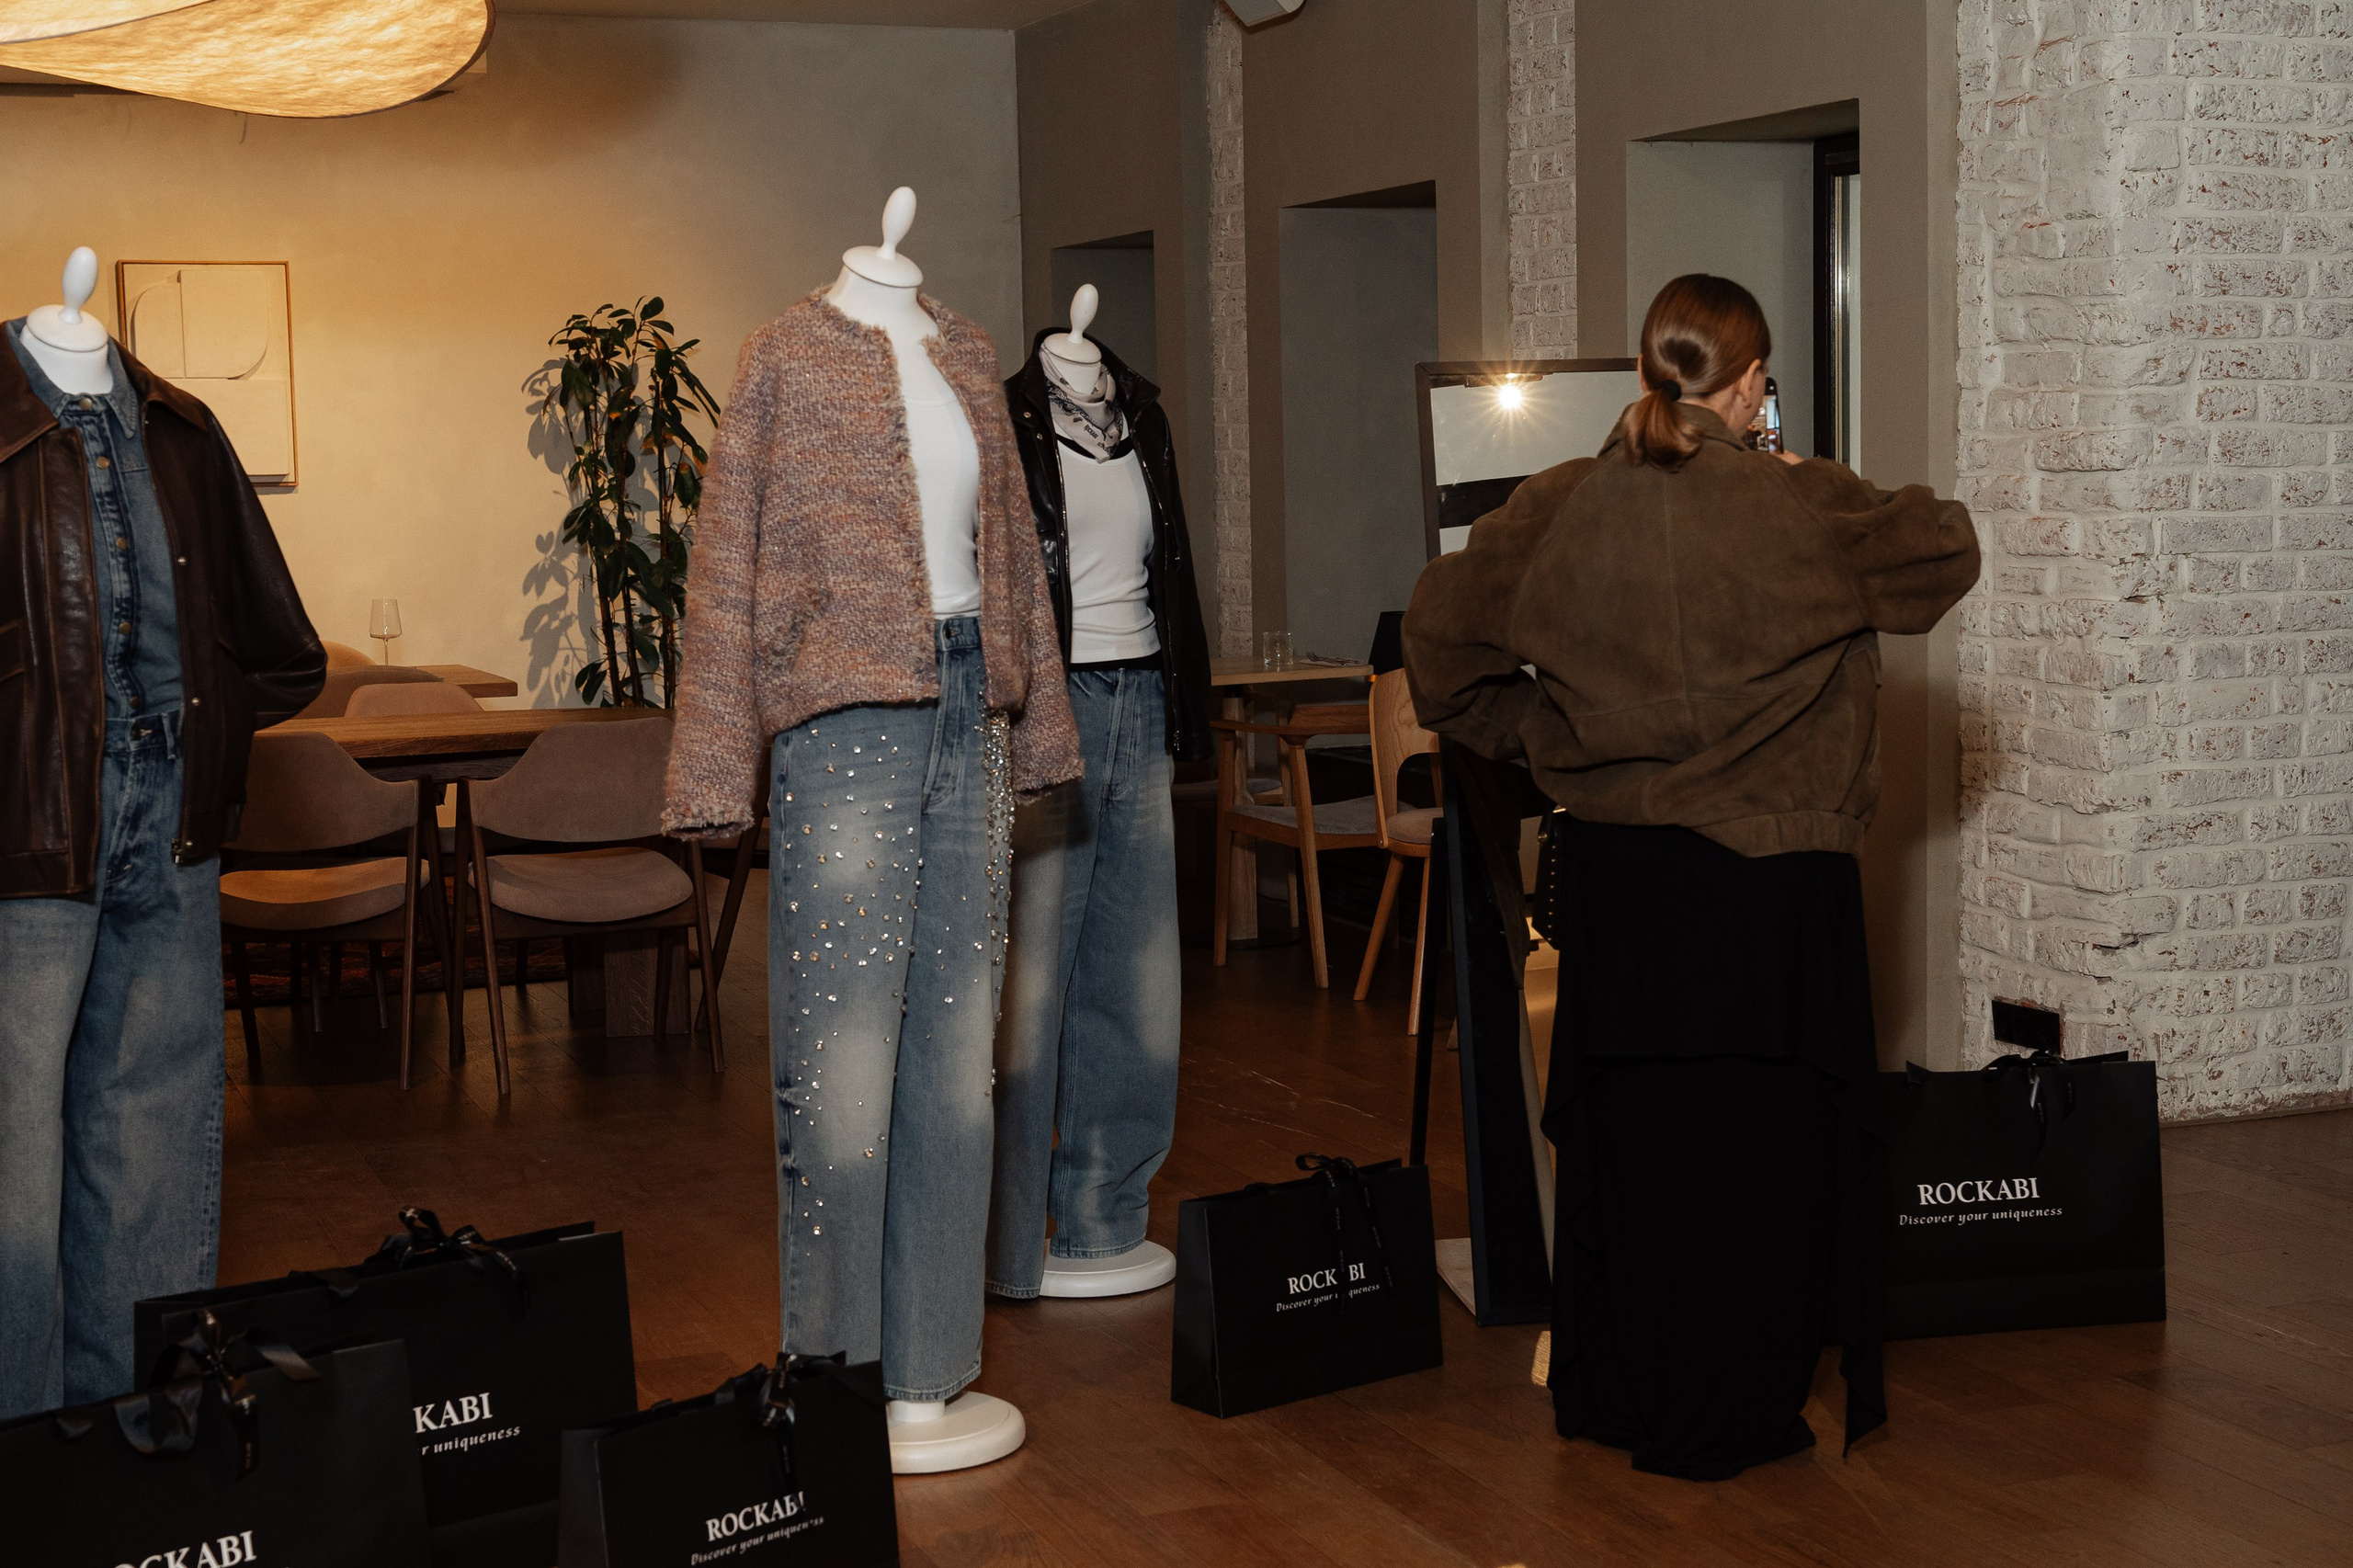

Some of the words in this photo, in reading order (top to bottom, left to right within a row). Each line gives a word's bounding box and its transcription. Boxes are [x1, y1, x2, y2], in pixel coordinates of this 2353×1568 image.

[1916, 1177, 2040, 1206] ROCKABI
[1899, 1214, 1955, 1225] Discover
[1958, 1212, 1989, 1226] your
[1992, 1208, 2063, 1221] uniqueness
[1287, 1262, 1366, 1294] ROCKBI
[1276, 1298, 1312, 1312] Discover
[1313, 1293, 1334, 1307] your
[1335, 1283, 1380, 1299] queness
[412, 1392, 494, 1434] KABI
[434, 1426, 520, 1452] uniqueness
[690, 1543, 738, 1566] Discover
[739, 1535, 765, 1555] your
[767, 1517, 824, 1540] uniquenss
